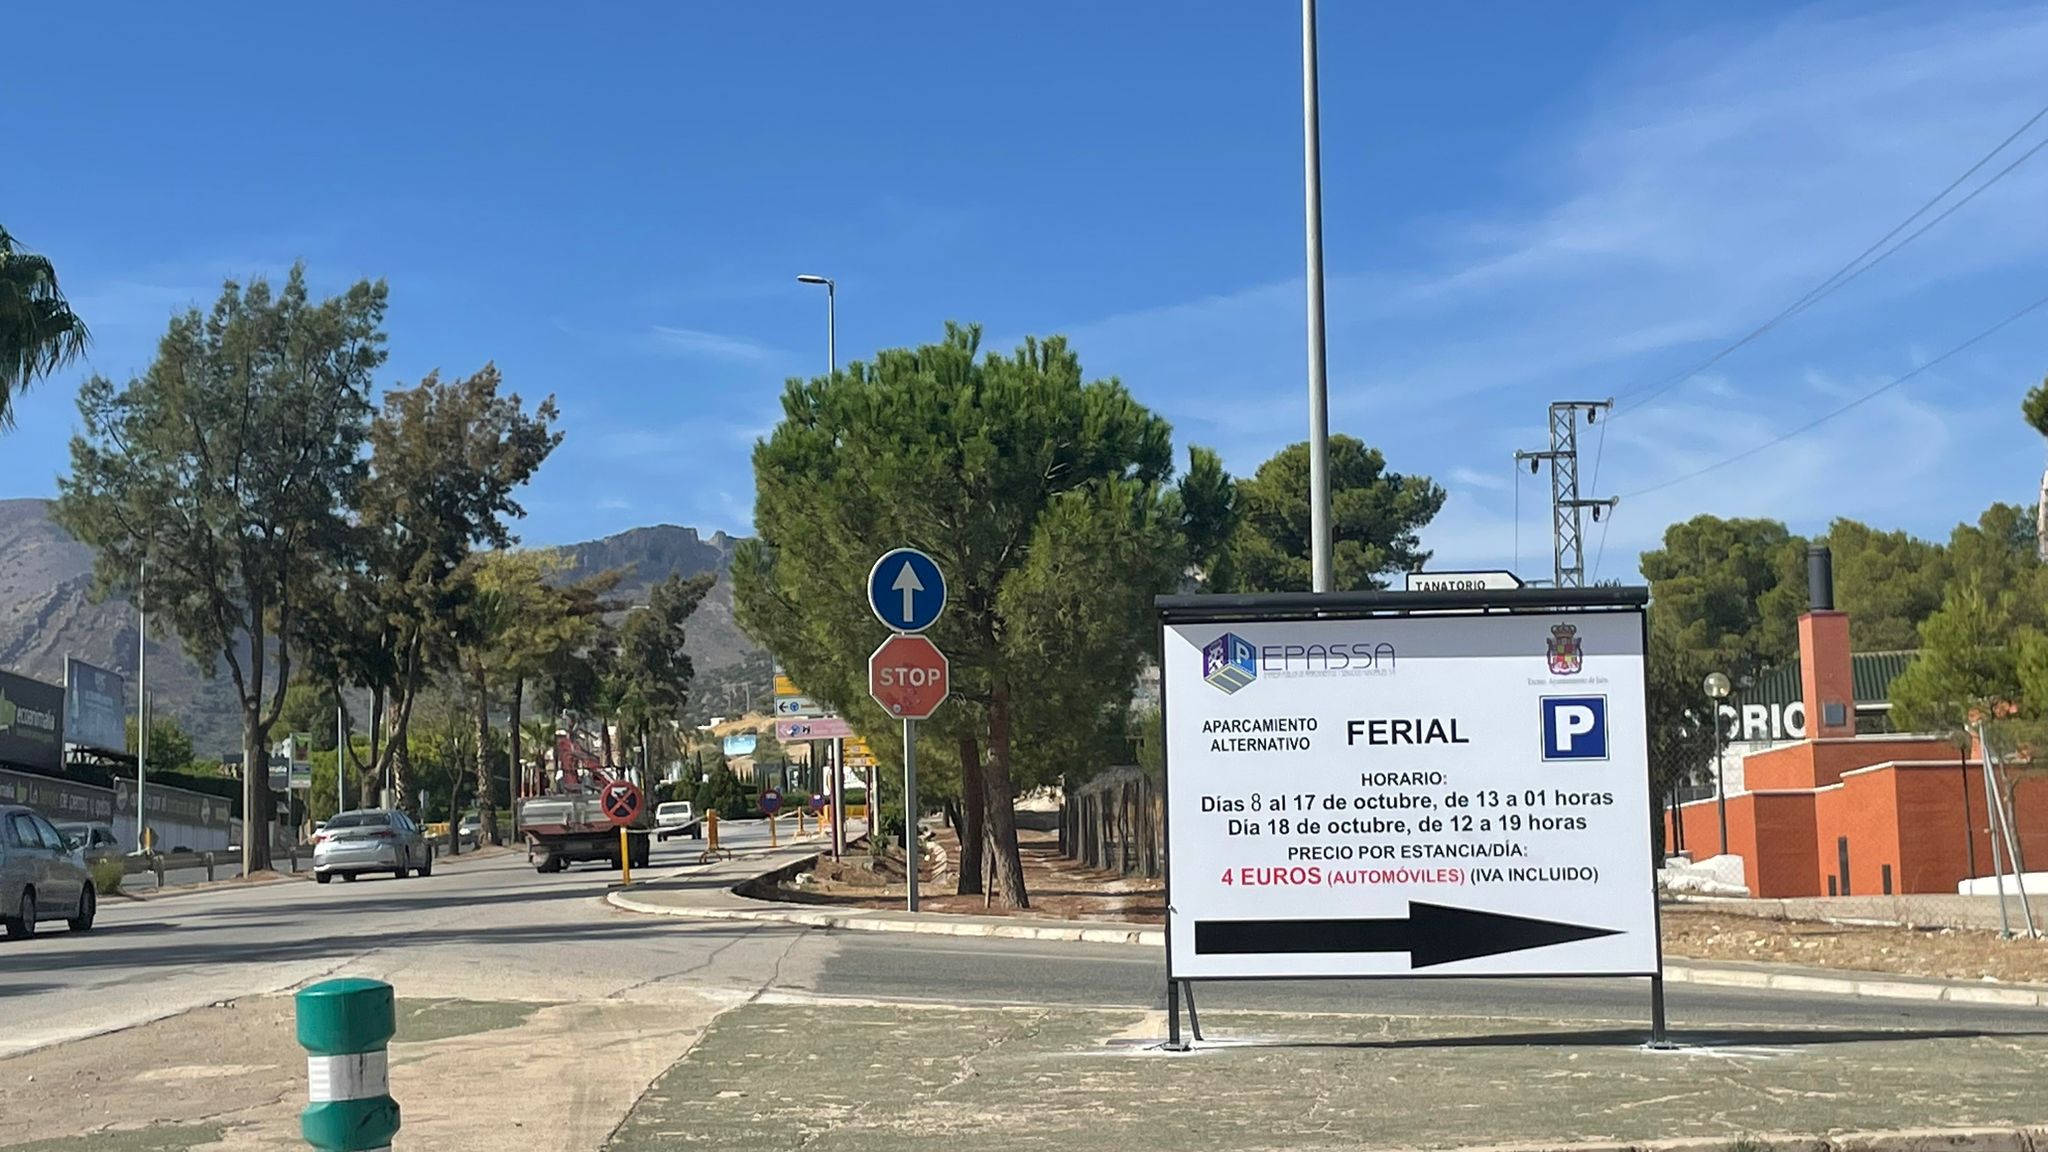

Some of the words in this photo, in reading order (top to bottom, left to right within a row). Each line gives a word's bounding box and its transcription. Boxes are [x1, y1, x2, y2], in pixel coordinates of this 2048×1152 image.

[1416, 580, 1486, 591] TANATORIO
[1263, 642, 1396, 671] EPASSA
[879, 667, 941, 687] STOP
[1202, 717, 1318, 733] APARCAMIENTO
[1347, 718, 1470, 746] FERIAL
[1555, 704, 1595, 751] P
[1210, 737, 1311, 752] ALTERNATIVO
[1361, 772, 1447, 786] HORARIO:
[1201, 796, 1245, 812] Días
[1251, 793, 1262, 812] 8
[1269, 795, 1286, 811] al
[1293, 794, 1316, 811] 17
[1323, 794, 1347, 810] de
[1353, 792, 1438, 811] octubre,
[1445, 792, 1469, 808] de
[1476, 790, 1499, 807] 13
[1506, 794, 1517, 807] a
[1524, 790, 1547, 806] 01
[1555, 790, 1614, 806] horas
[1228, 819, 1260, 835] Día
[1267, 818, 1290, 835] 18
[1296, 818, 1320, 834] de
[1327, 817, 1411, 836] octubre,
[1418, 816, 1443, 832] de
[1450, 815, 1473, 832] 12
[1480, 818, 1491, 831] a
[1499, 814, 1521, 831] 19
[1529, 813, 1587, 830] horas
[1288, 846, 1353, 860] PRECIO
[1358, 845, 1395, 859] POR
[1400, 840, 1528, 858] ESTANCIA/DÍA:
[1221, 868, 1233, 886] 4
[1241, 867, 1322, 885] EUROS
[1327, 866, 1465, 888] (AUTOMÓVILES)
[1470, 868, 1504, 885] (IVA
[1508, 867, 1599, 883] INCLUIDO)
